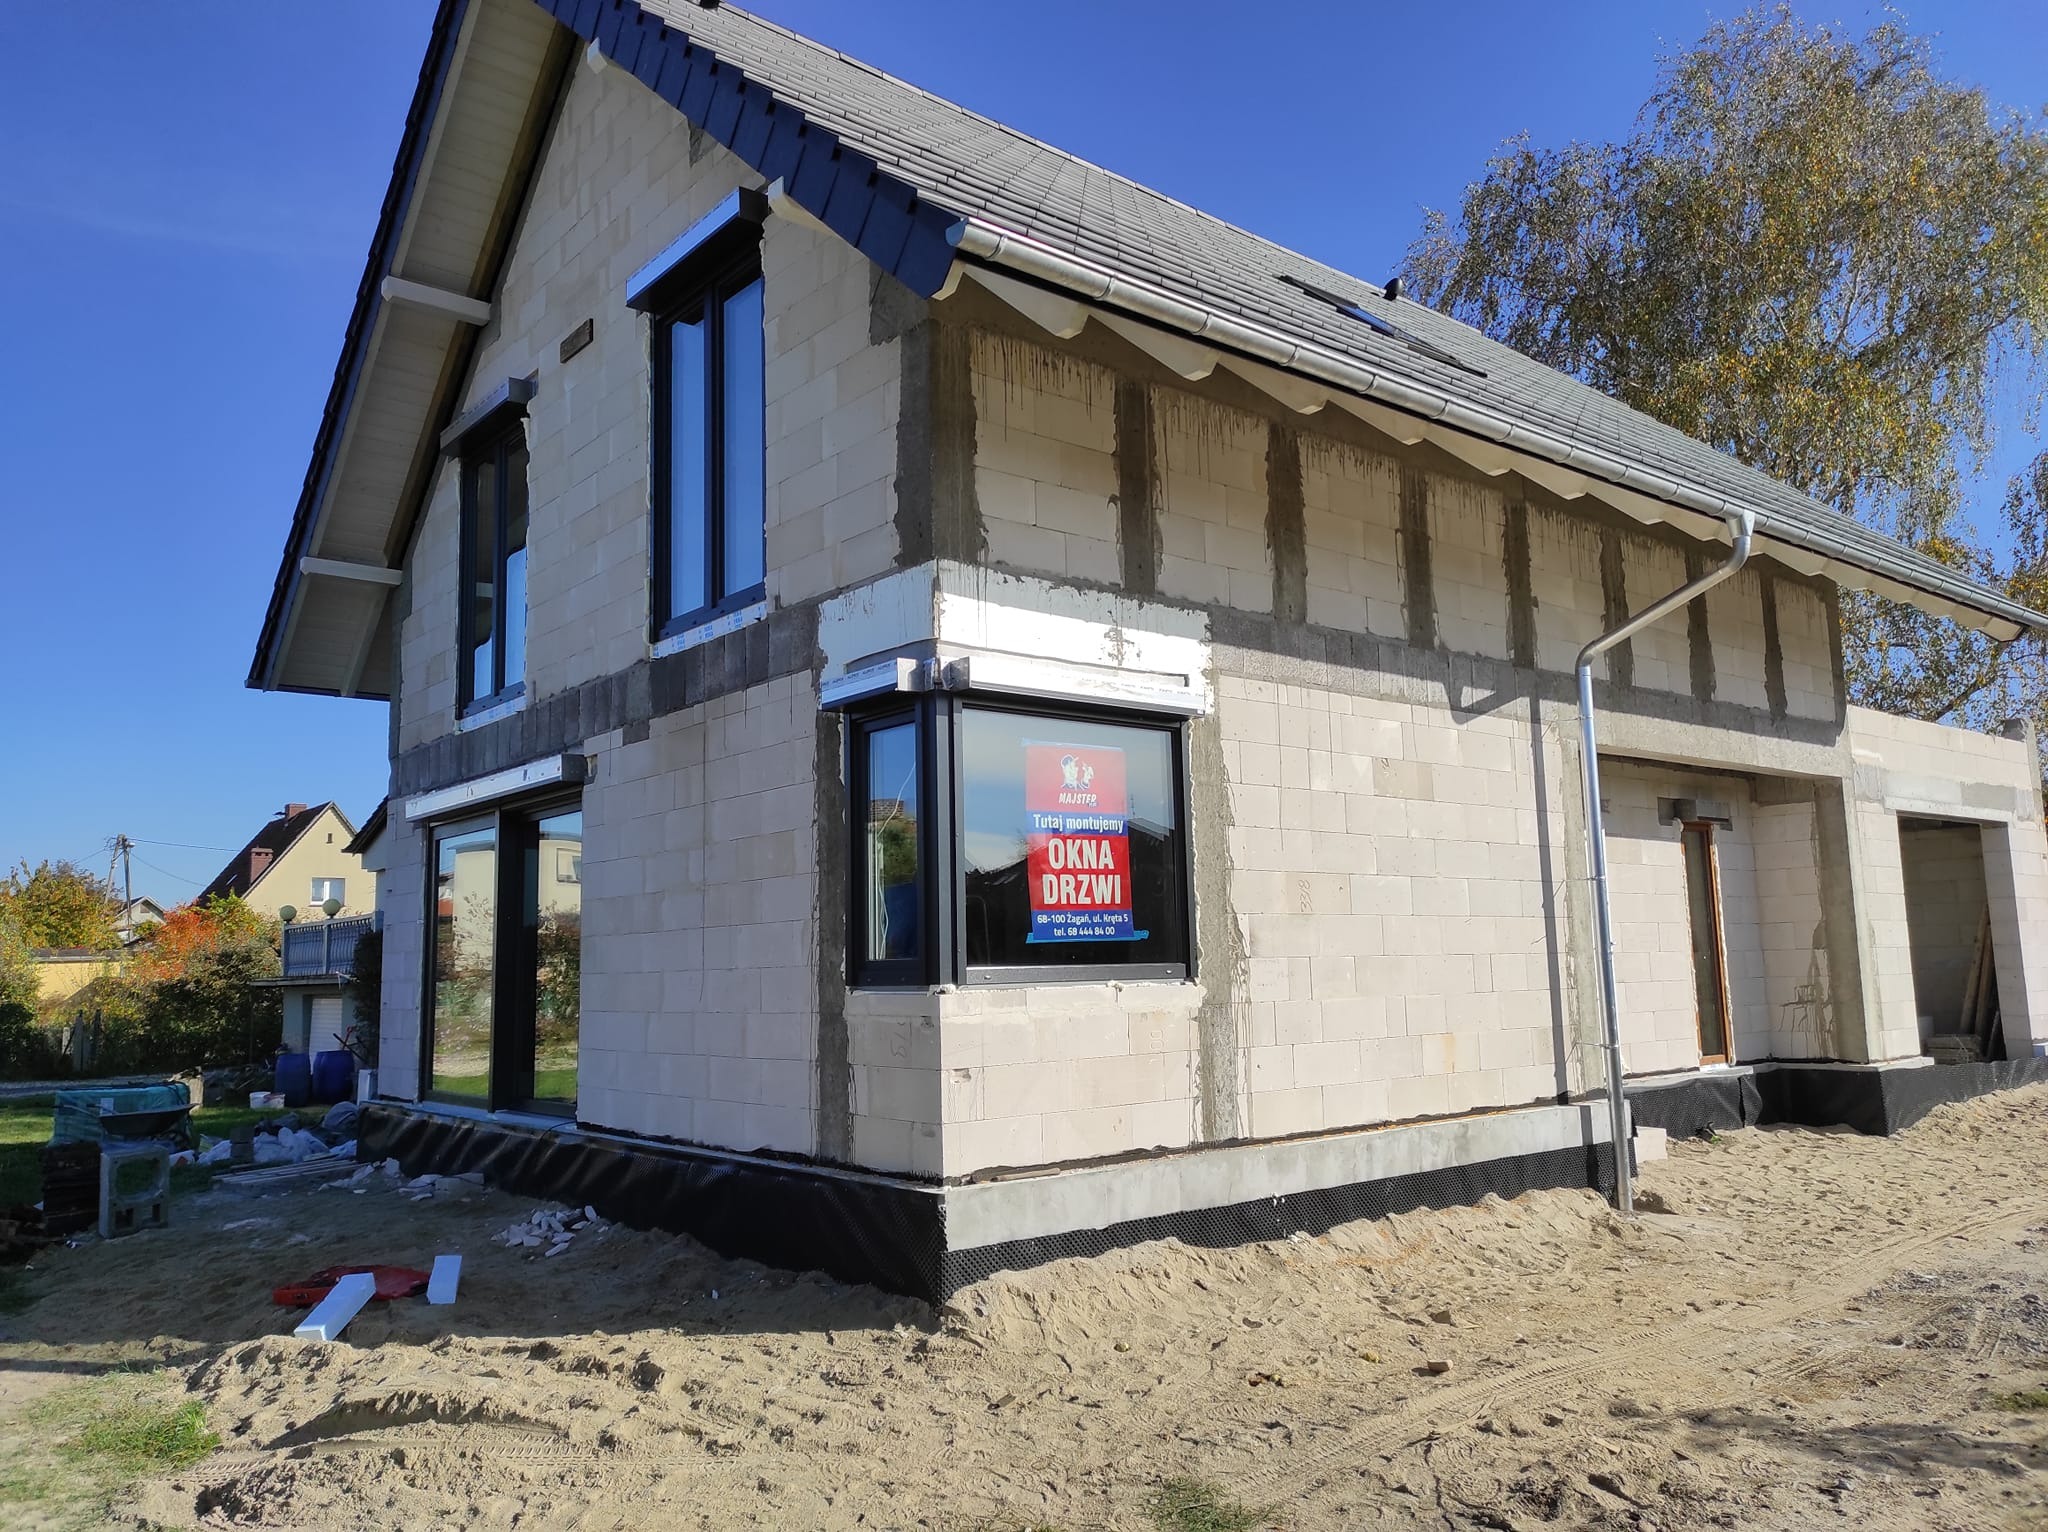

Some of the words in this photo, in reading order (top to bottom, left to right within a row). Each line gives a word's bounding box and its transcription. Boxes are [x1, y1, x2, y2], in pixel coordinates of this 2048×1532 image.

[1033, 814, 1063, 831] Tutaj
[1066, 816, 1124, 834] montujemy
[1048, 838, 1115, 870] OKNA
[1042, 873, 1121, 905] DRZWI
[1037, 914, 1066, 924] 68-100
[1093, 913, 1102, 923] ul.
[1054, 927, 1066, 936] tel.
[1067, 927, 1078, 936] 68
[1079, 927, 1094, 936] 444
[1094, 926, 1104, 936] 84
[1105, 926, 1115, 936] 00
